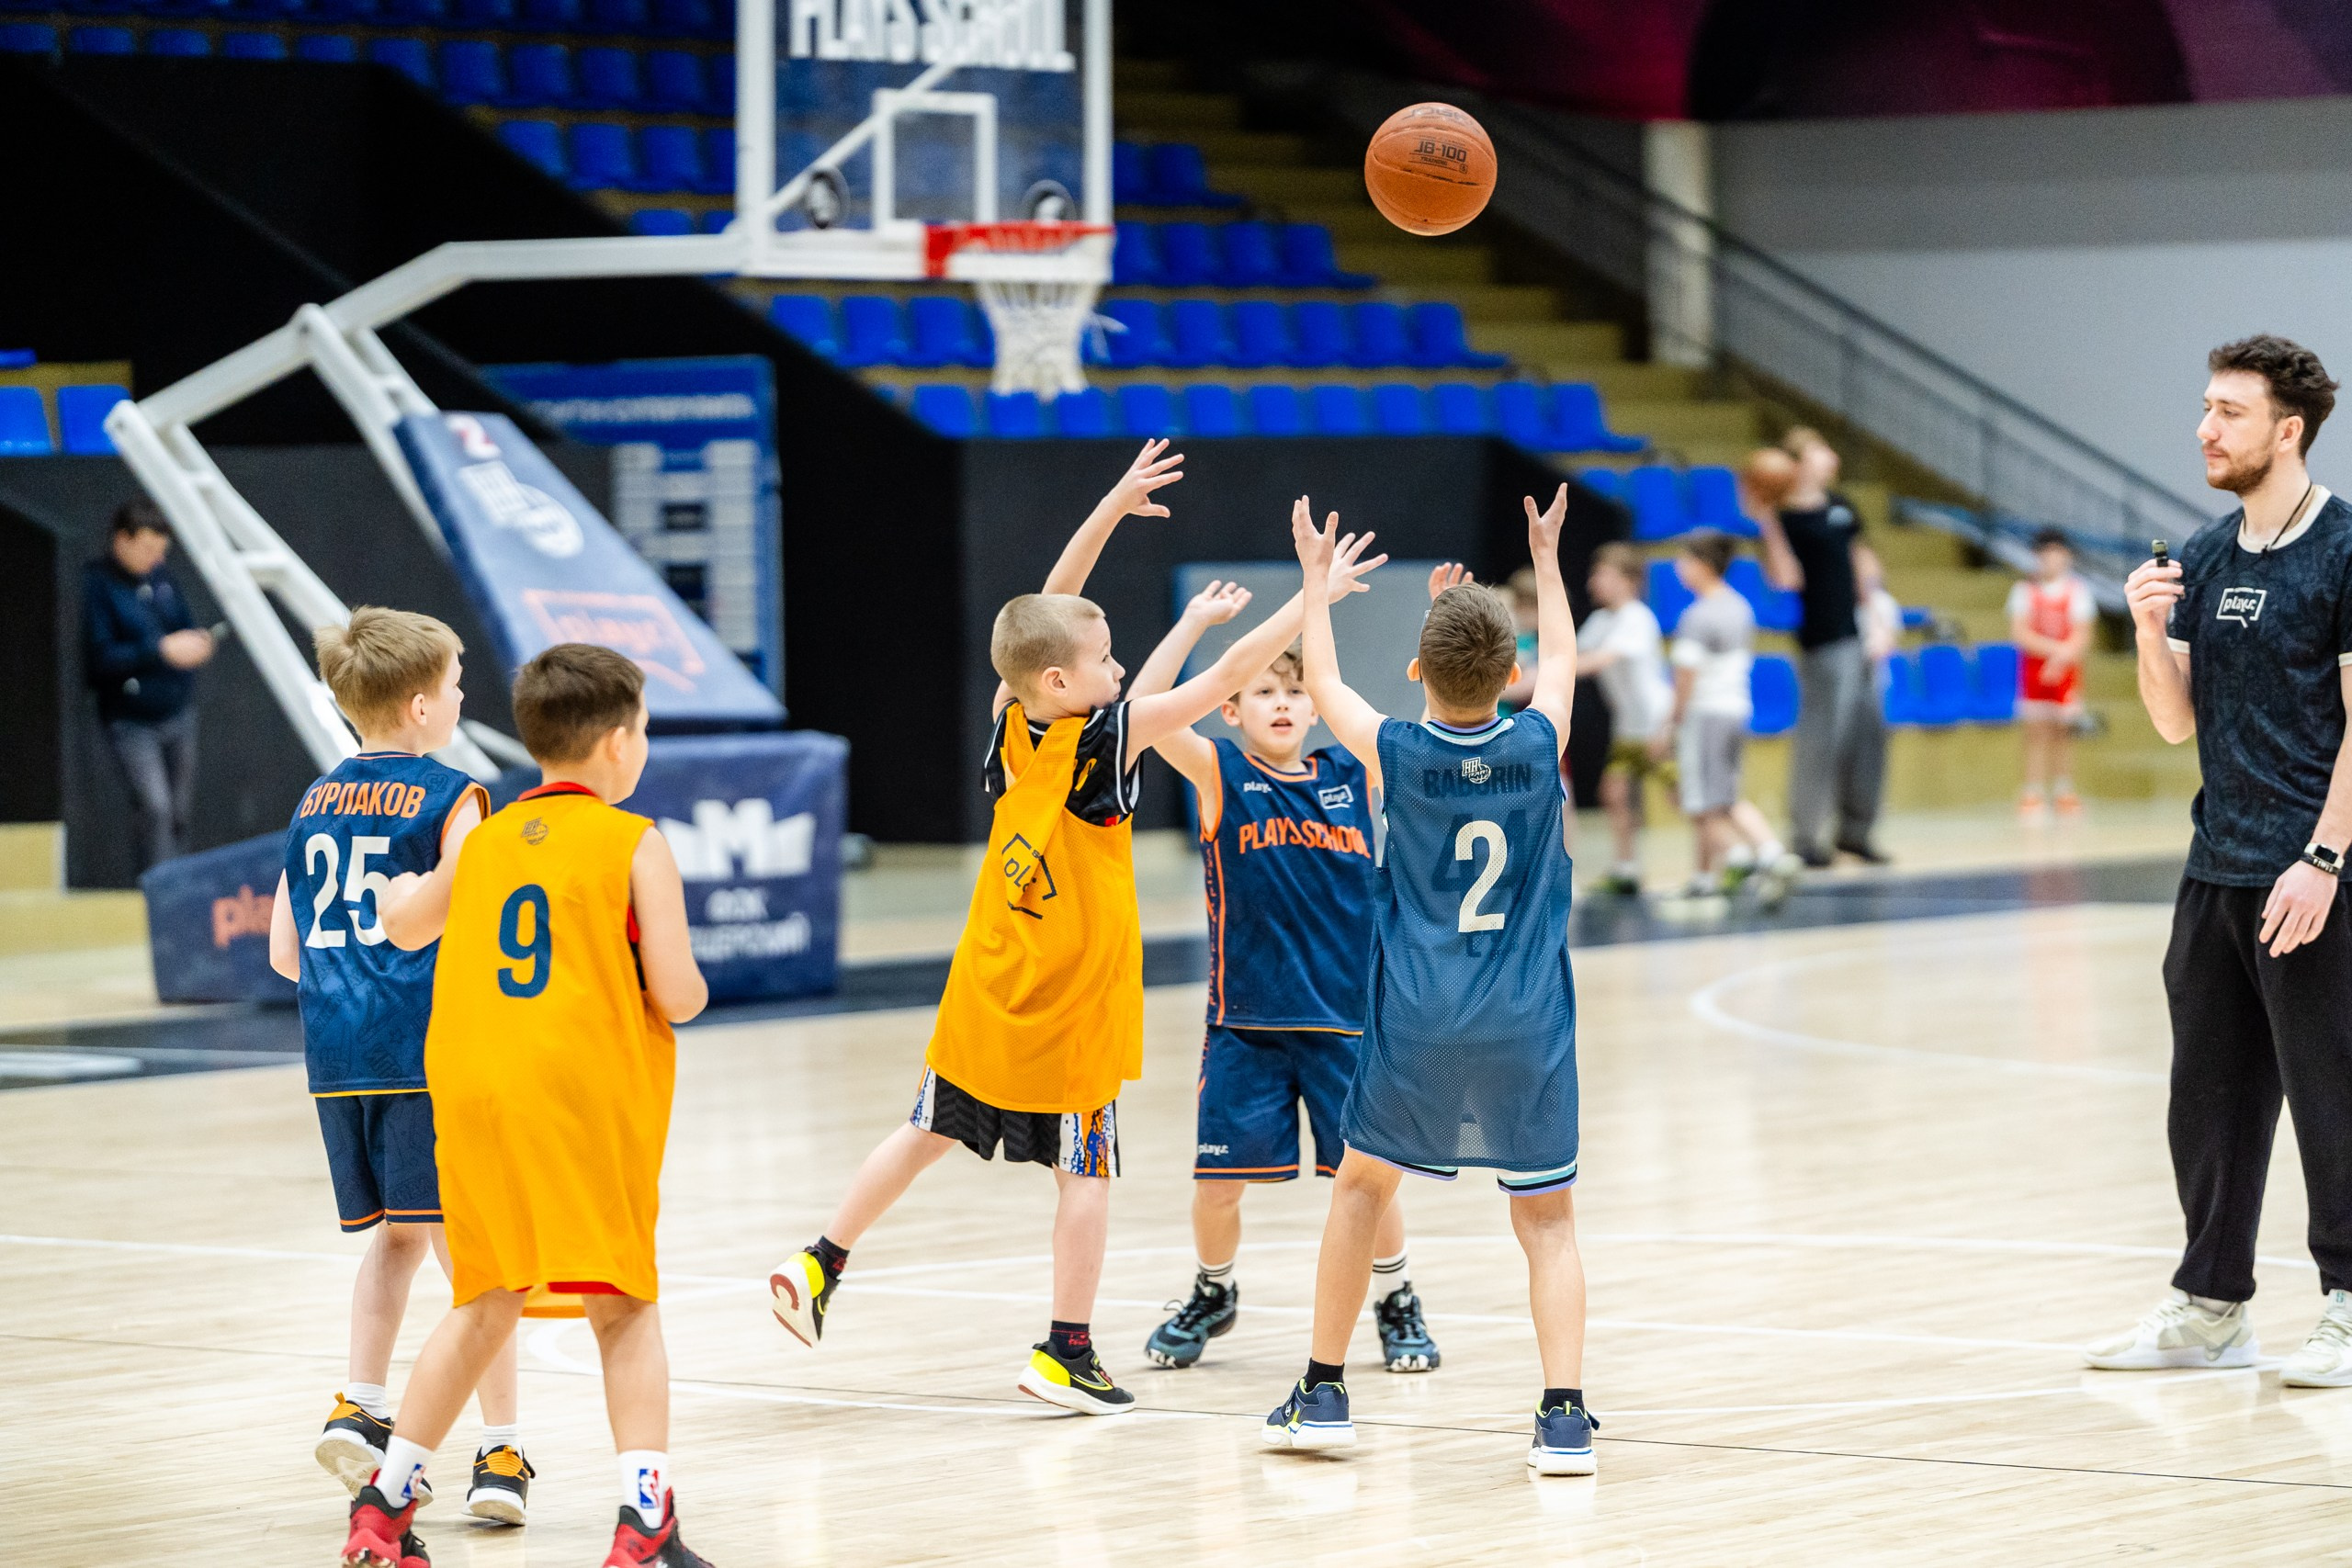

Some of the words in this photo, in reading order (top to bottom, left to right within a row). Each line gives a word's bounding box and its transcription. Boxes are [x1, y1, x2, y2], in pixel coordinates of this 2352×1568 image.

[1413, 141, 1467, 163] JB-100
[300, 782, 426, 819] БУРЛАКОВ
[305, 833, 390, 949] 25
[1454, 819, 1508, 933] 2
[498, 884, 552, 999] 9
